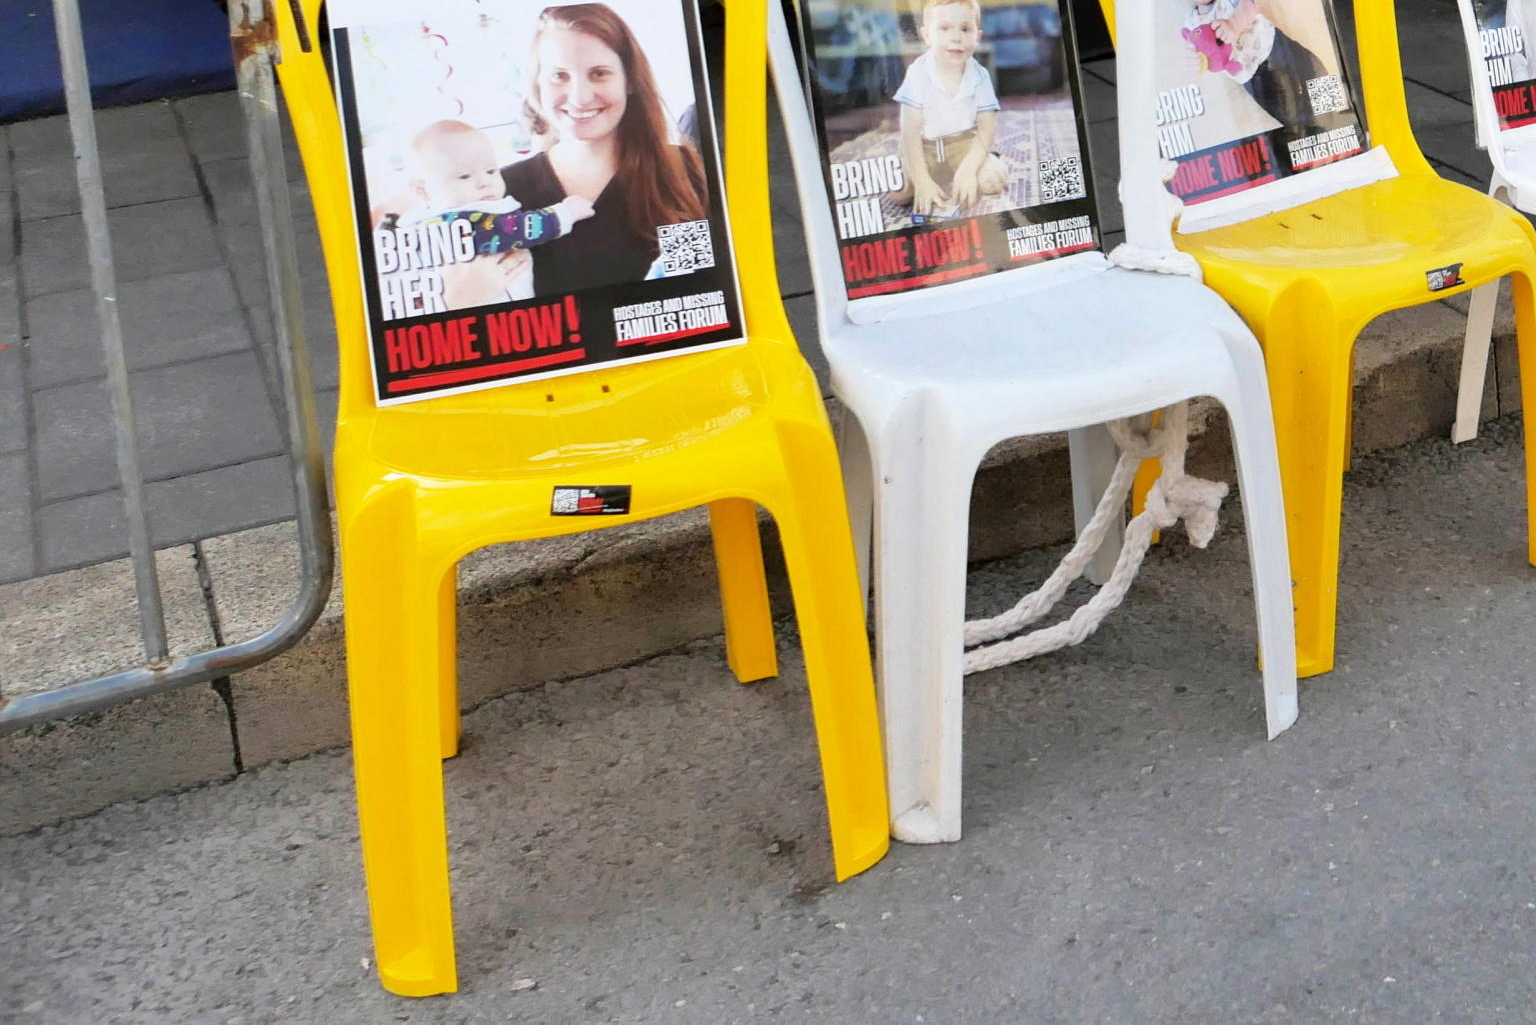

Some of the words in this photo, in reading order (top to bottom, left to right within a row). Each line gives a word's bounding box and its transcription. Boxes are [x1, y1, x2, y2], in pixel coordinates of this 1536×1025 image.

[1479, 27, 1523, 57] BRING
[1486, 56, 1512, 87] HIM
[1158, 123, 1195, 159] HIM
[1217, 135, 1272, 183] NOW!
[1287, 135, 1317, 151] HOSTAGES
[1317, 133, 1330, 144] AND
[1290, 143, 1328, 168] FAMILIES
[1328, 135, 1360, 155] FORUM
[830, 154, 904, 200] BRING
[837, 198, 885, 240] HIM
[1007, 223, 1042, 239] HOSTAGES
[1043, 220, 1057, 232] AND
[1058, 215, 1091, 229] MISSING
[374, 219, 476, 274] BRING
[842, 236, 911, 282] HOME
[913, 218, 984, 269] NOW!
[1008, 234, 1055, 257] FAMILIES
[1056, 227, 1093, 249] FORUM
[382, 271, 447, 321] HER
[613, 302, 662, 321] HOSTAGES
[662, 298, 682, 314] AND
[682, 291, 725, 311] MISSING
[384, 315, 481, 373] HOME
[488, 295, 581, 356] NOW!
[615, 314, 677, 342] FAMILIES
[677, 305, 728, 333] FORUM
